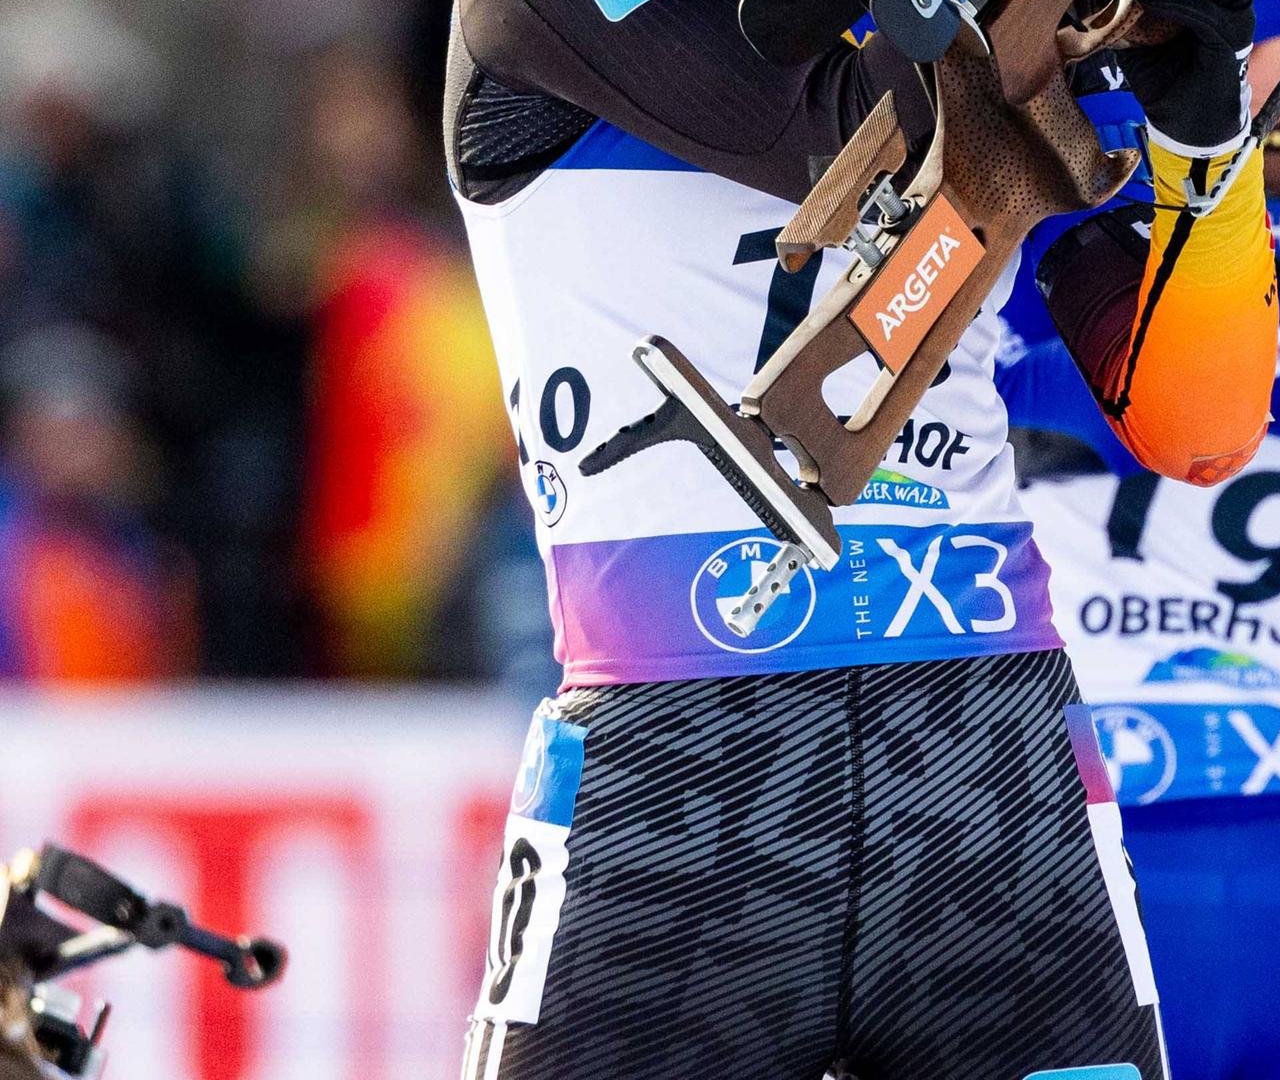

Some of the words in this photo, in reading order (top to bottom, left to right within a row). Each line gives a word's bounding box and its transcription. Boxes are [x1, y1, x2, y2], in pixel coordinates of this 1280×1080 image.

[874, 232, 961, 343] ARGETA
[849, 538, 869, 583] NEW
[875, 534, 1018, 638] X3
[853, 594, 872, 640] THE
